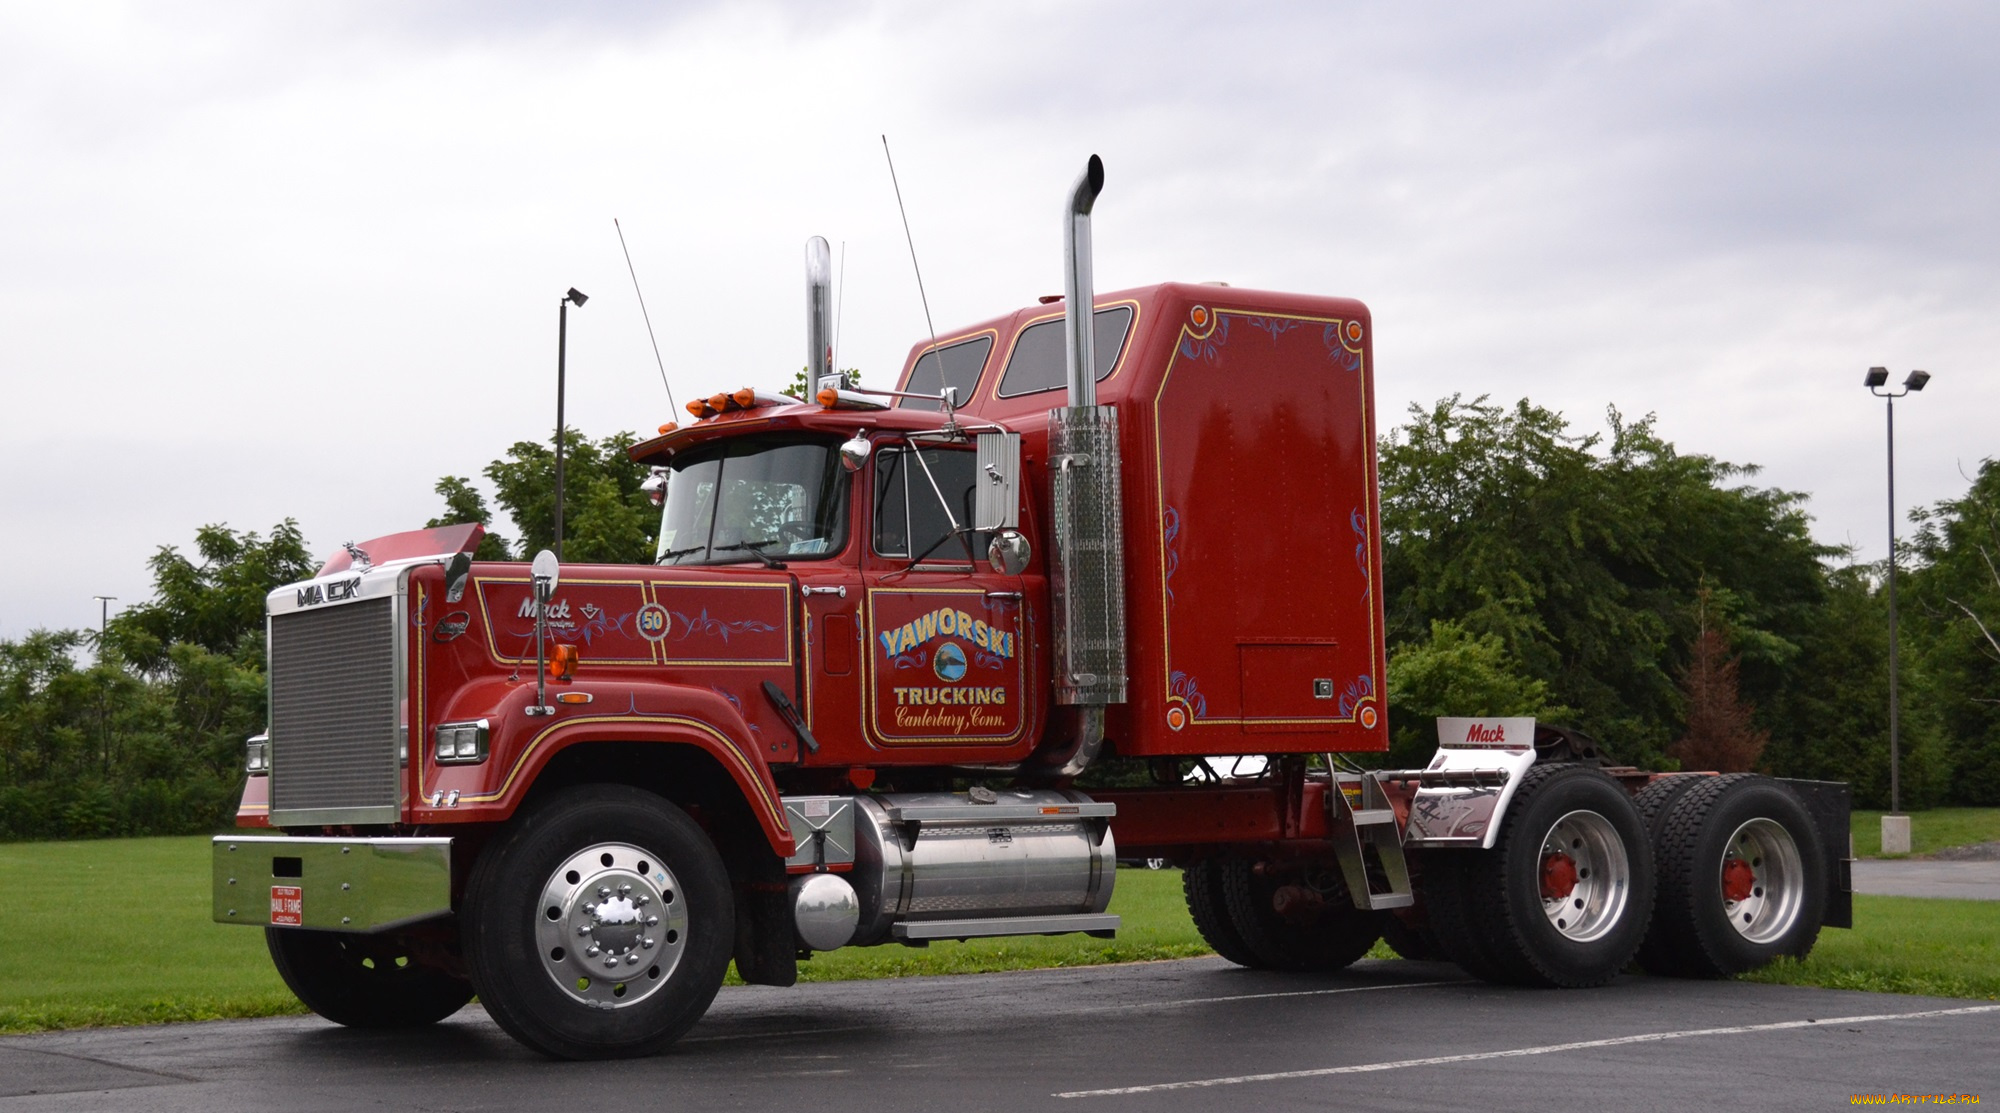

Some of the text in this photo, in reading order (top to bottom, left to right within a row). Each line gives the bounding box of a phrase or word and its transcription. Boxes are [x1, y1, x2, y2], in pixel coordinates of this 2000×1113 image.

[297, 577, 361, 608] MACK
[641, 611, 663, 630] 50
[879, 607, 1014, 659] YAWORSKI
[893, 686, 1006, 705] TRUCKING
[895, 706, 1006, 735] Canterbury, Conn.
[1465, 723, 1505, 743] Mack
